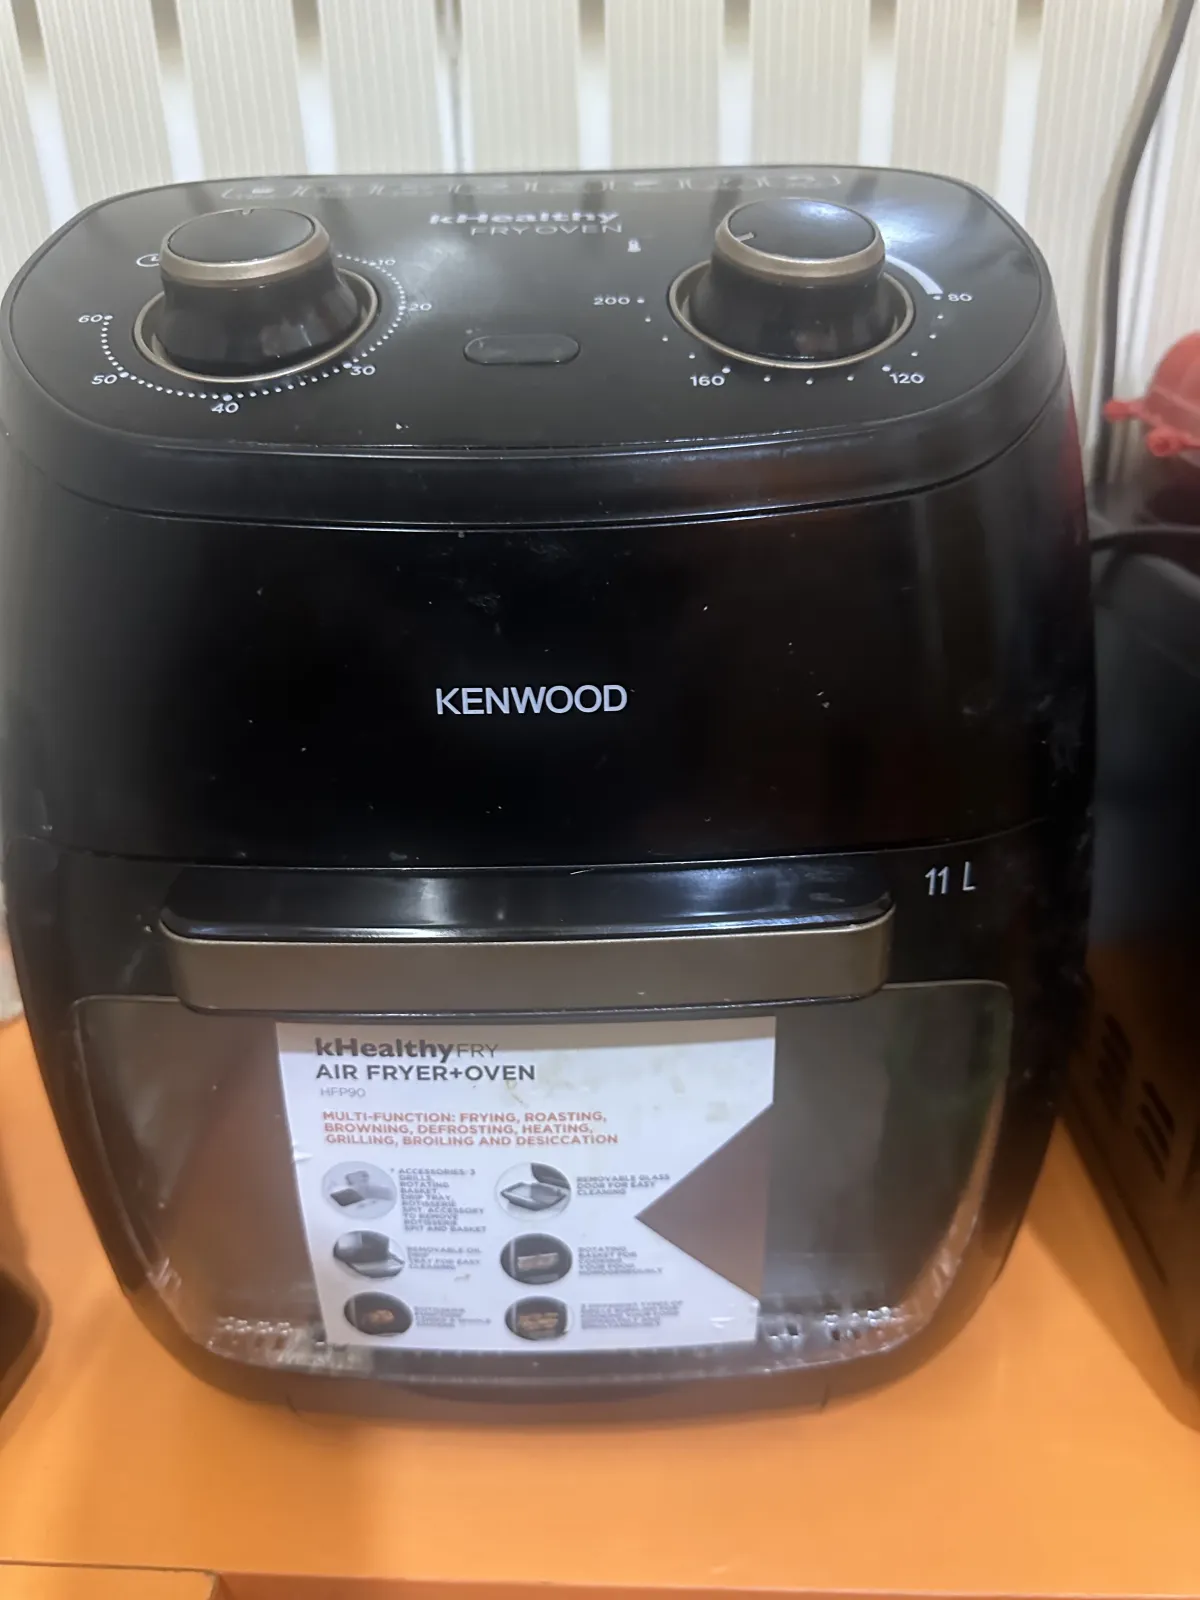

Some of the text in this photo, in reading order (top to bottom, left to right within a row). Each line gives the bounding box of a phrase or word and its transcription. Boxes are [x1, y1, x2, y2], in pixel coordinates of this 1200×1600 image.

[429, 210, 620, 225] kHealthy
[593, 296, 630, 305] 200
[947, 292, 972, 302] 80
[410, 302, 432, 311] 20
[78, 314, 103, 324] 60
[350, 364, 376, 376] 30
[91, 374, 118, 385] 50
[690, 374, 725, 387] 160
[889, 373, 924, 384] 120
[211, 401, 239, 414] 40
[435, 684, 628, 715] KENWOOD
[924, 861, 977, 896] 11 L
[316, 1064, 535, 1081] AIR FRYER+OVEN
[320, 1087, 366, 1098] HFP90
[322, 1111, 607, 1124] MULTI-FUNCTION: FRYING, ROASTING,
[324, 1123, 593, 1135] BROWNING, DEFROSTING, HEATING,
[326, 1134, 618, 1147] GRILLING, BROILING AND DESICCATION
